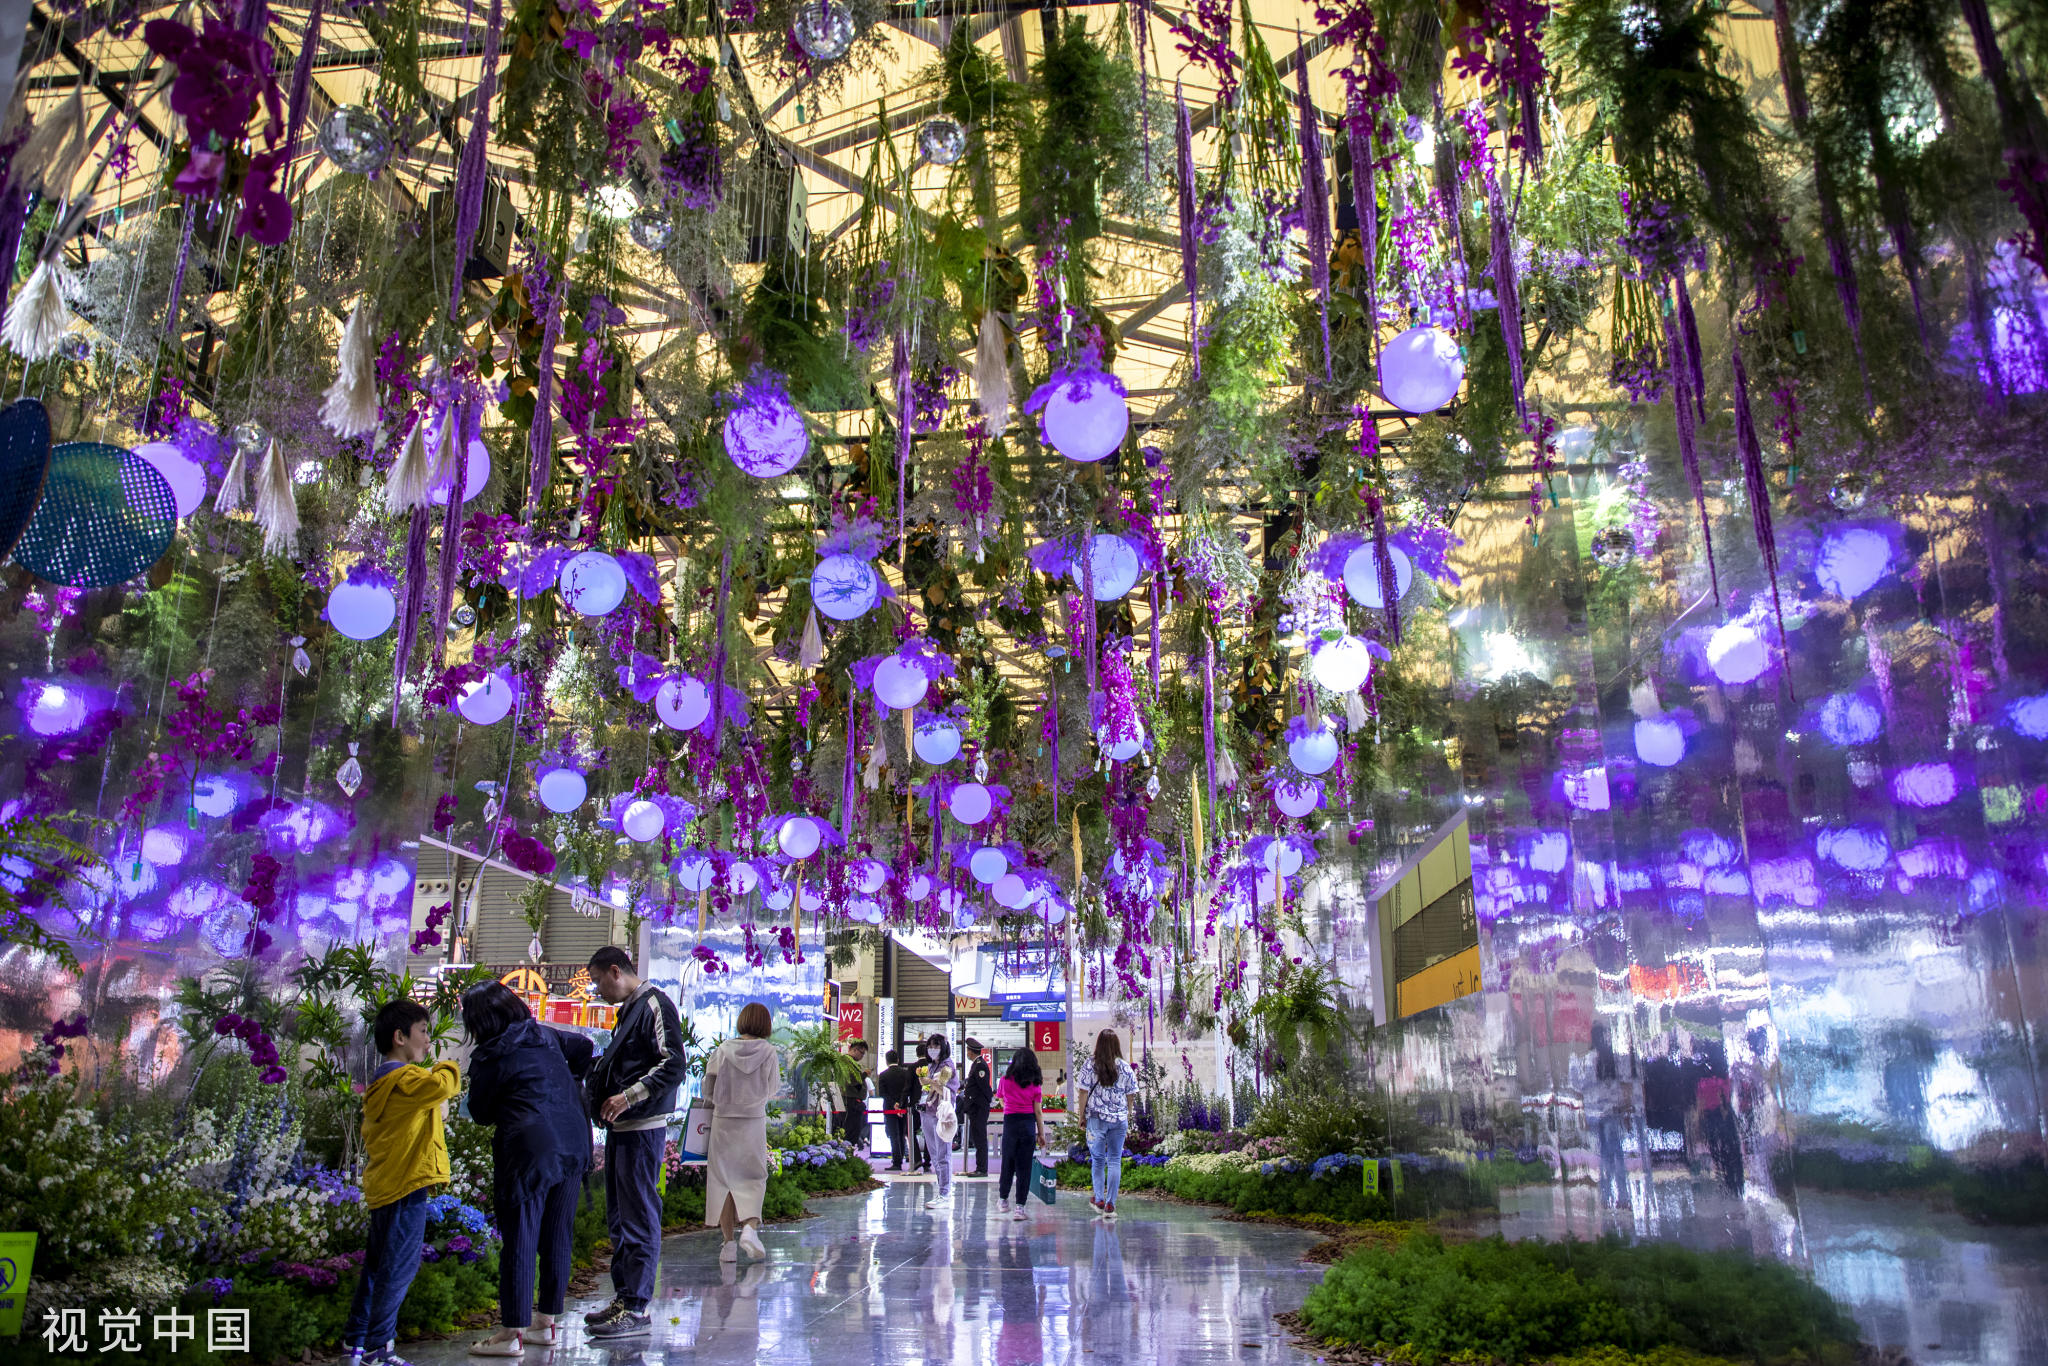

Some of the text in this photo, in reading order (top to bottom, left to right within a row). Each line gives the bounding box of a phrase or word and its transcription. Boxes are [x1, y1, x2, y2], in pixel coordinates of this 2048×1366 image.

[955, 996, 977, 1009] W3
[840, 1008, 862, 1022] W2
[1042, 1031, 1052, 1045] 6
[982, 1053, 992, 1064] 3
